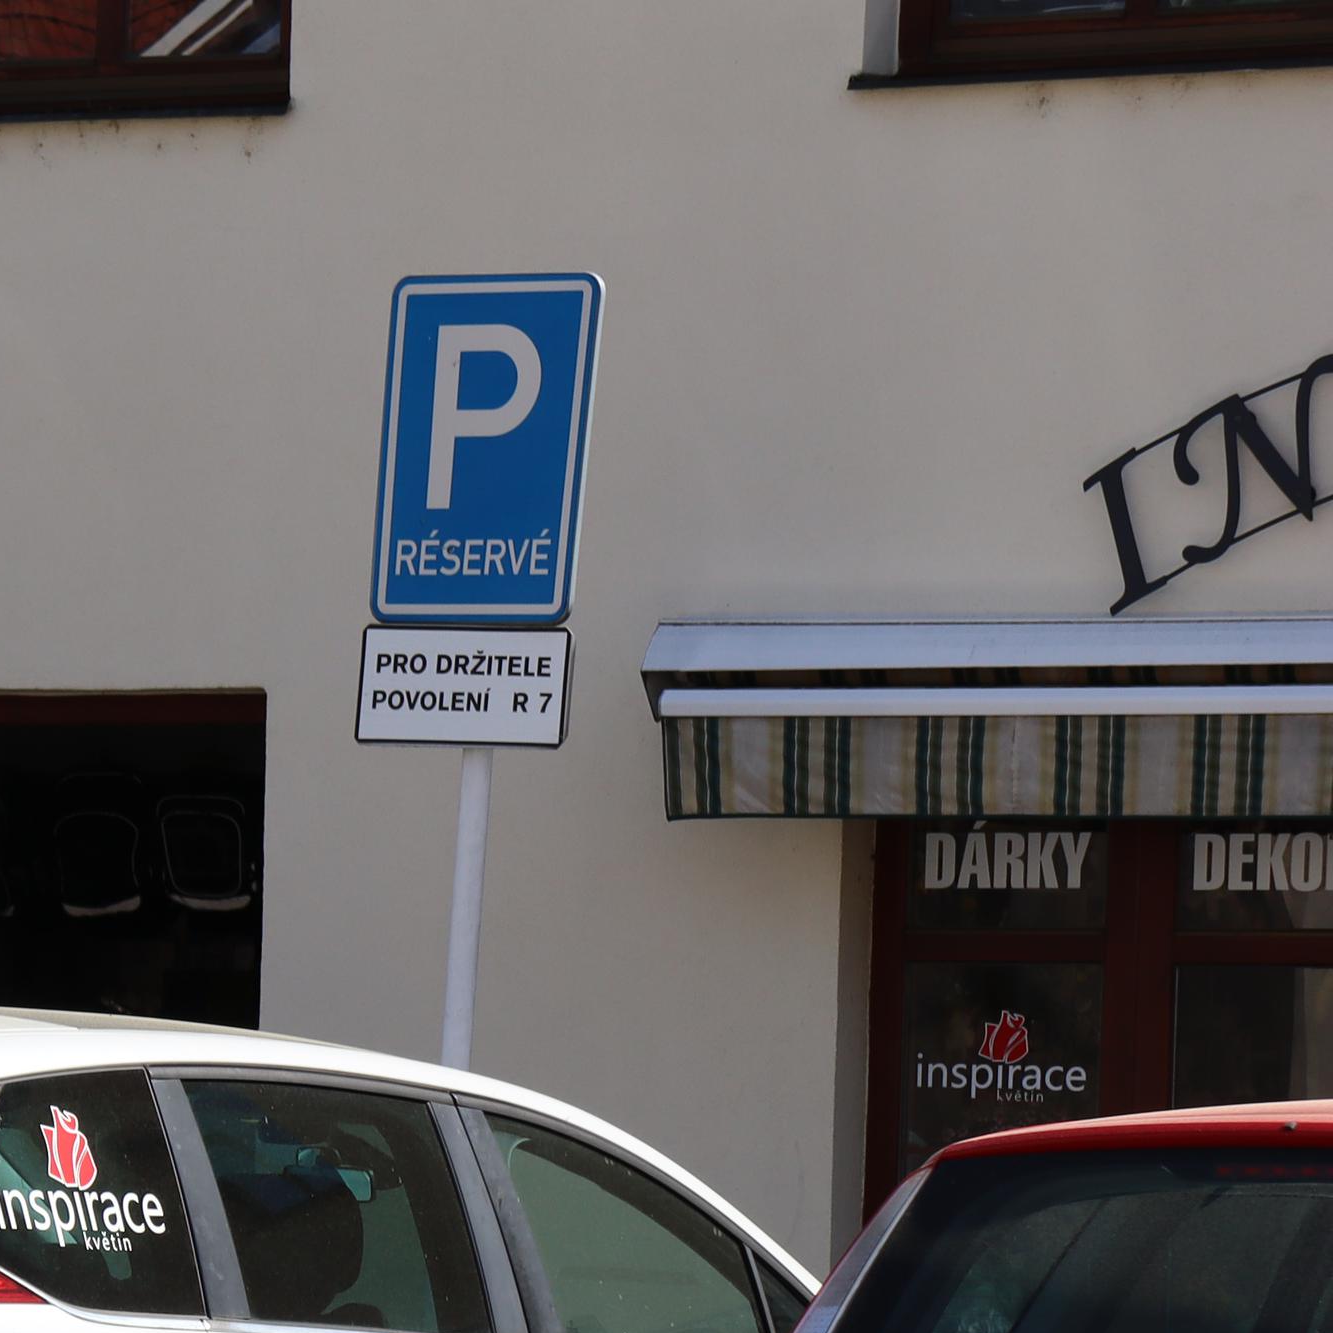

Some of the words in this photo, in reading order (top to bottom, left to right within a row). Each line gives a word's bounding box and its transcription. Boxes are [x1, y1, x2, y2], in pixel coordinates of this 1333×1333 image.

[426, 324, 542, 510] P
[394, 529, 552, 577] RÉSERVÉ
[375, 653, 428, 675] PRO
[435, 650, 552, 678] DRŽITELE
[371, 687, 491, 713] POVOLENÍ
[511, 692, 529, 713] R
[539, 693, 554, 714] 7
[924, 821, 1092, 890] DÁRKY
[916, 1053, 1088, 1099] inspirace
[995, 1089, 1045, 1103] květin
[83, 1230, 133, 1252] květin
